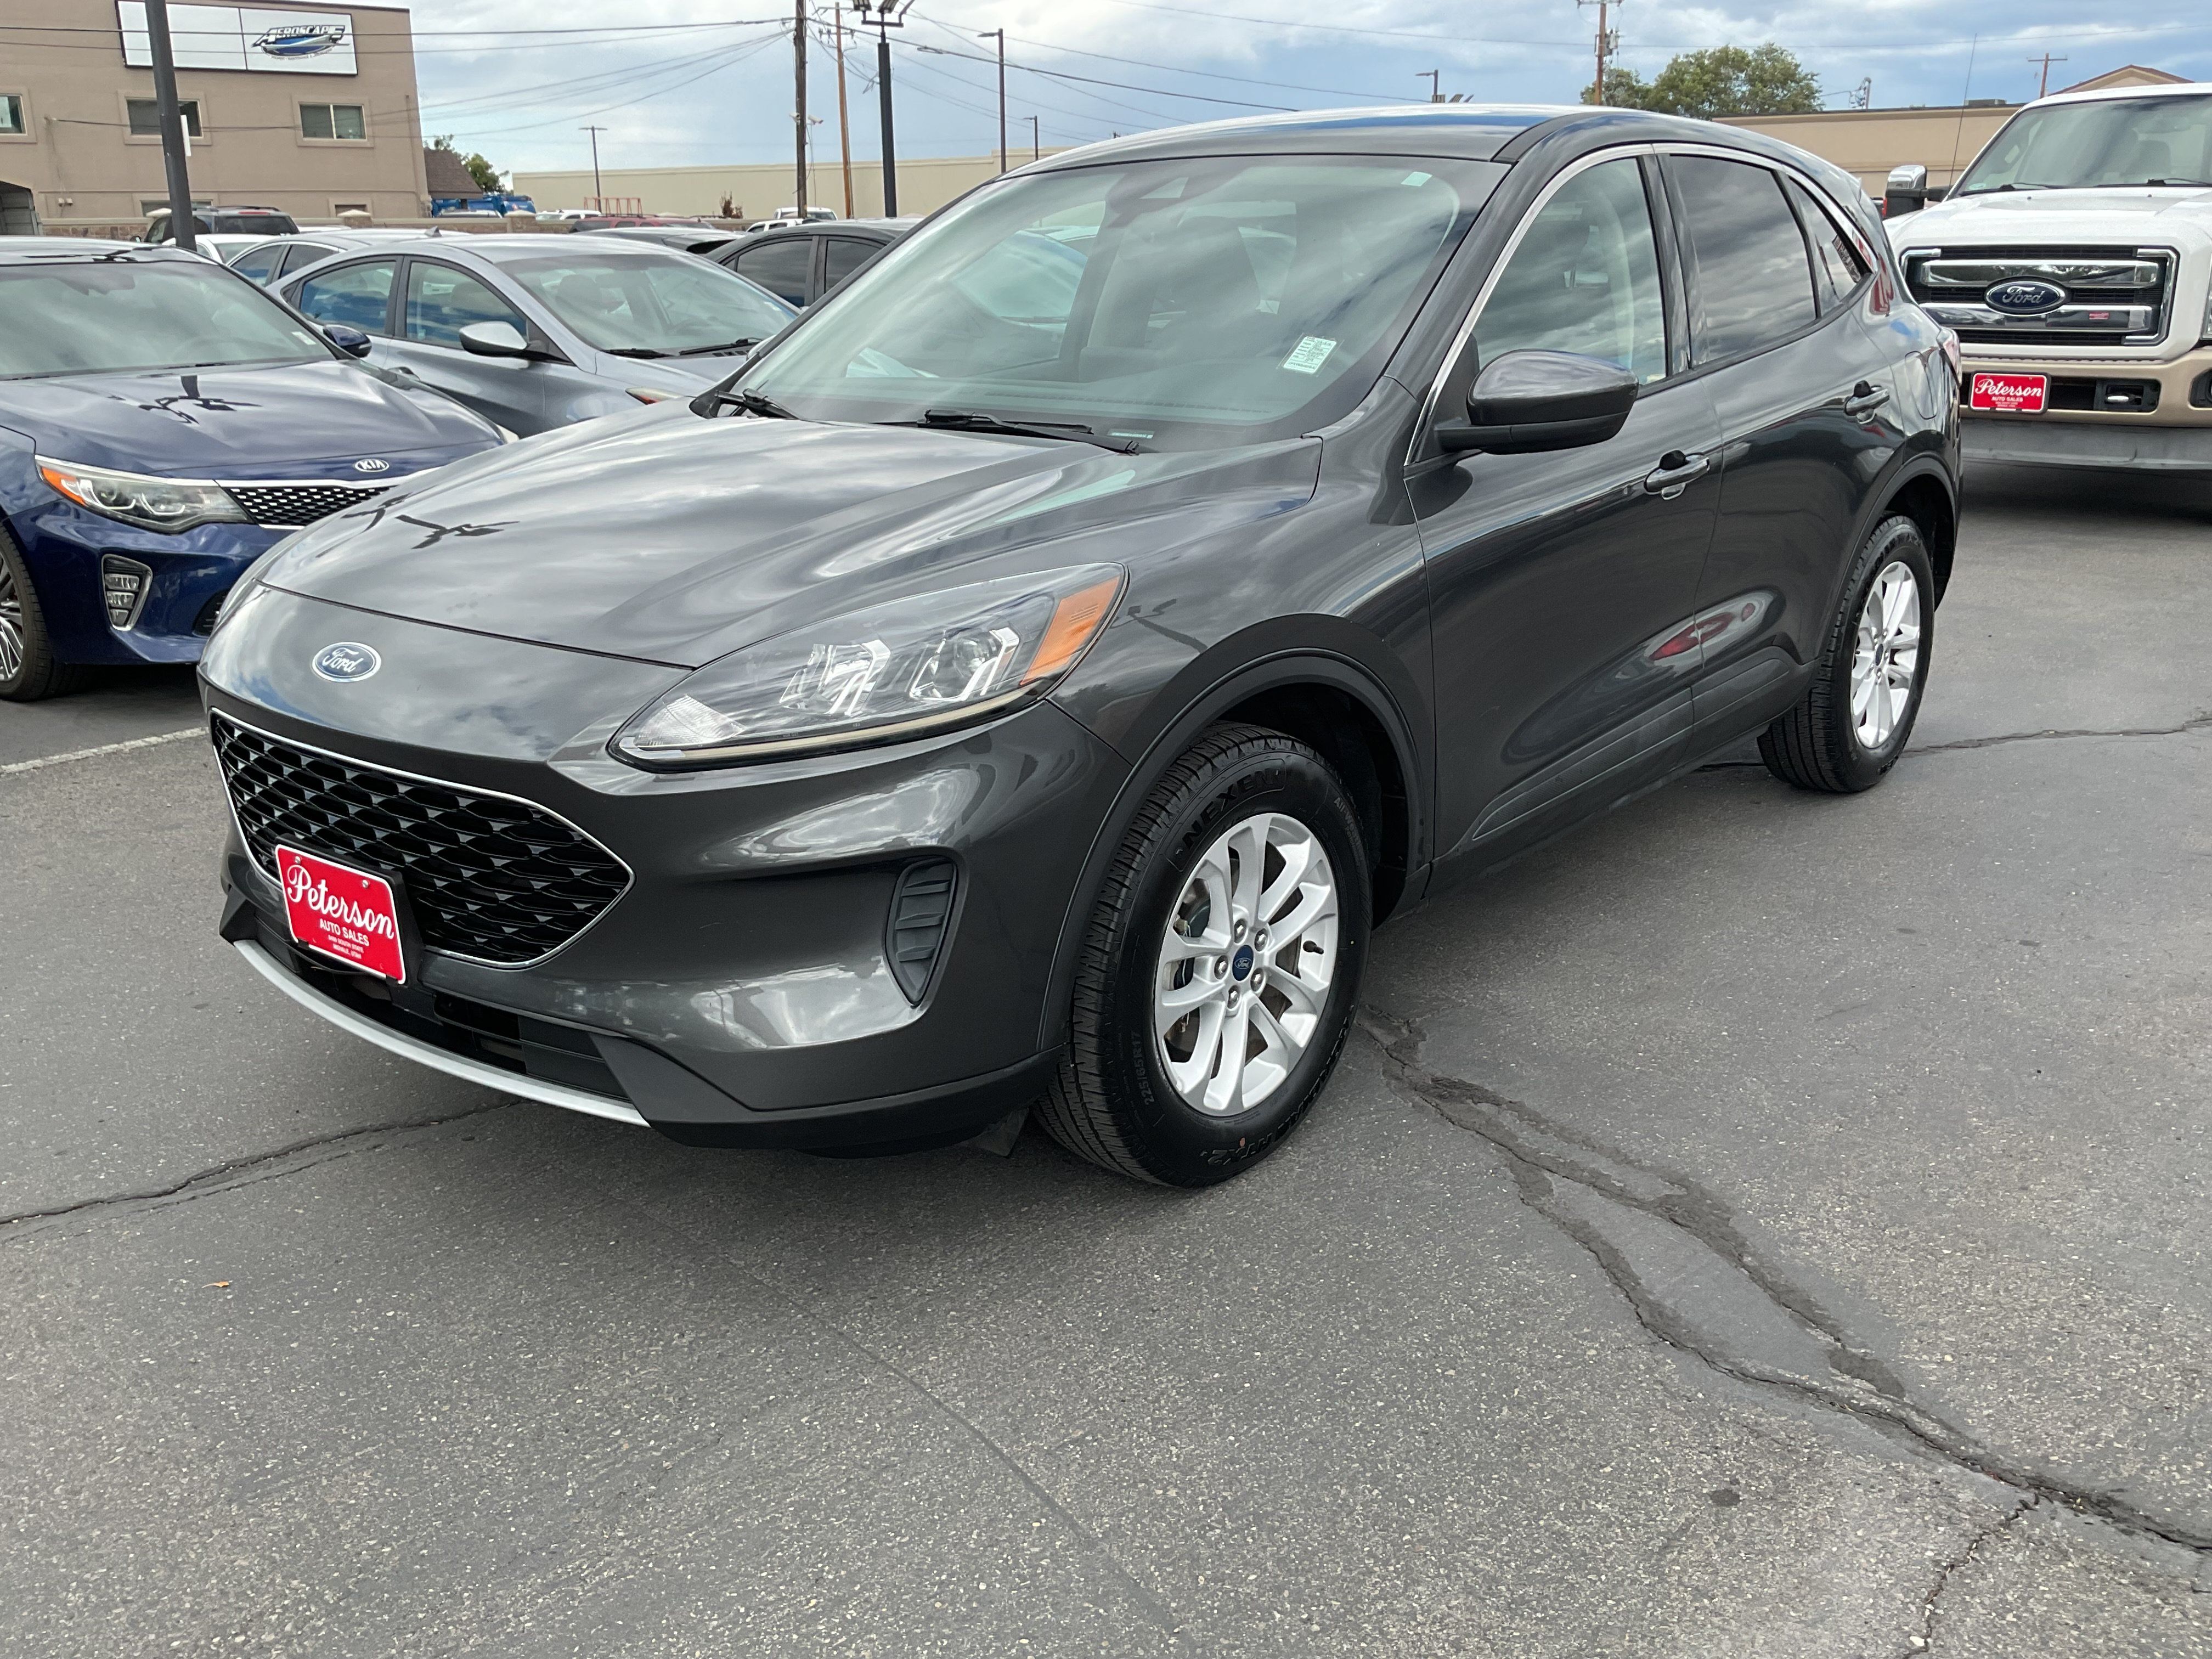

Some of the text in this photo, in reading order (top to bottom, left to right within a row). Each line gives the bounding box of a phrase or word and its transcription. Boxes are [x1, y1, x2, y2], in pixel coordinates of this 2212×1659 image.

[2002, 286, 2045, 303] Ford
[1975, 379, 2042, 397] Peterson
[359, 460, 386, 470] KIA
[322, 647, 364, 673] Ford
[1182, 768, 1277, 850] NEXEN
[287, 865, 394, 939] Peterson
[320, 918, 341, 935] AUTO
[342, 927, 370, 947] SALES
[1237, 959, 1250, 967] Ford
